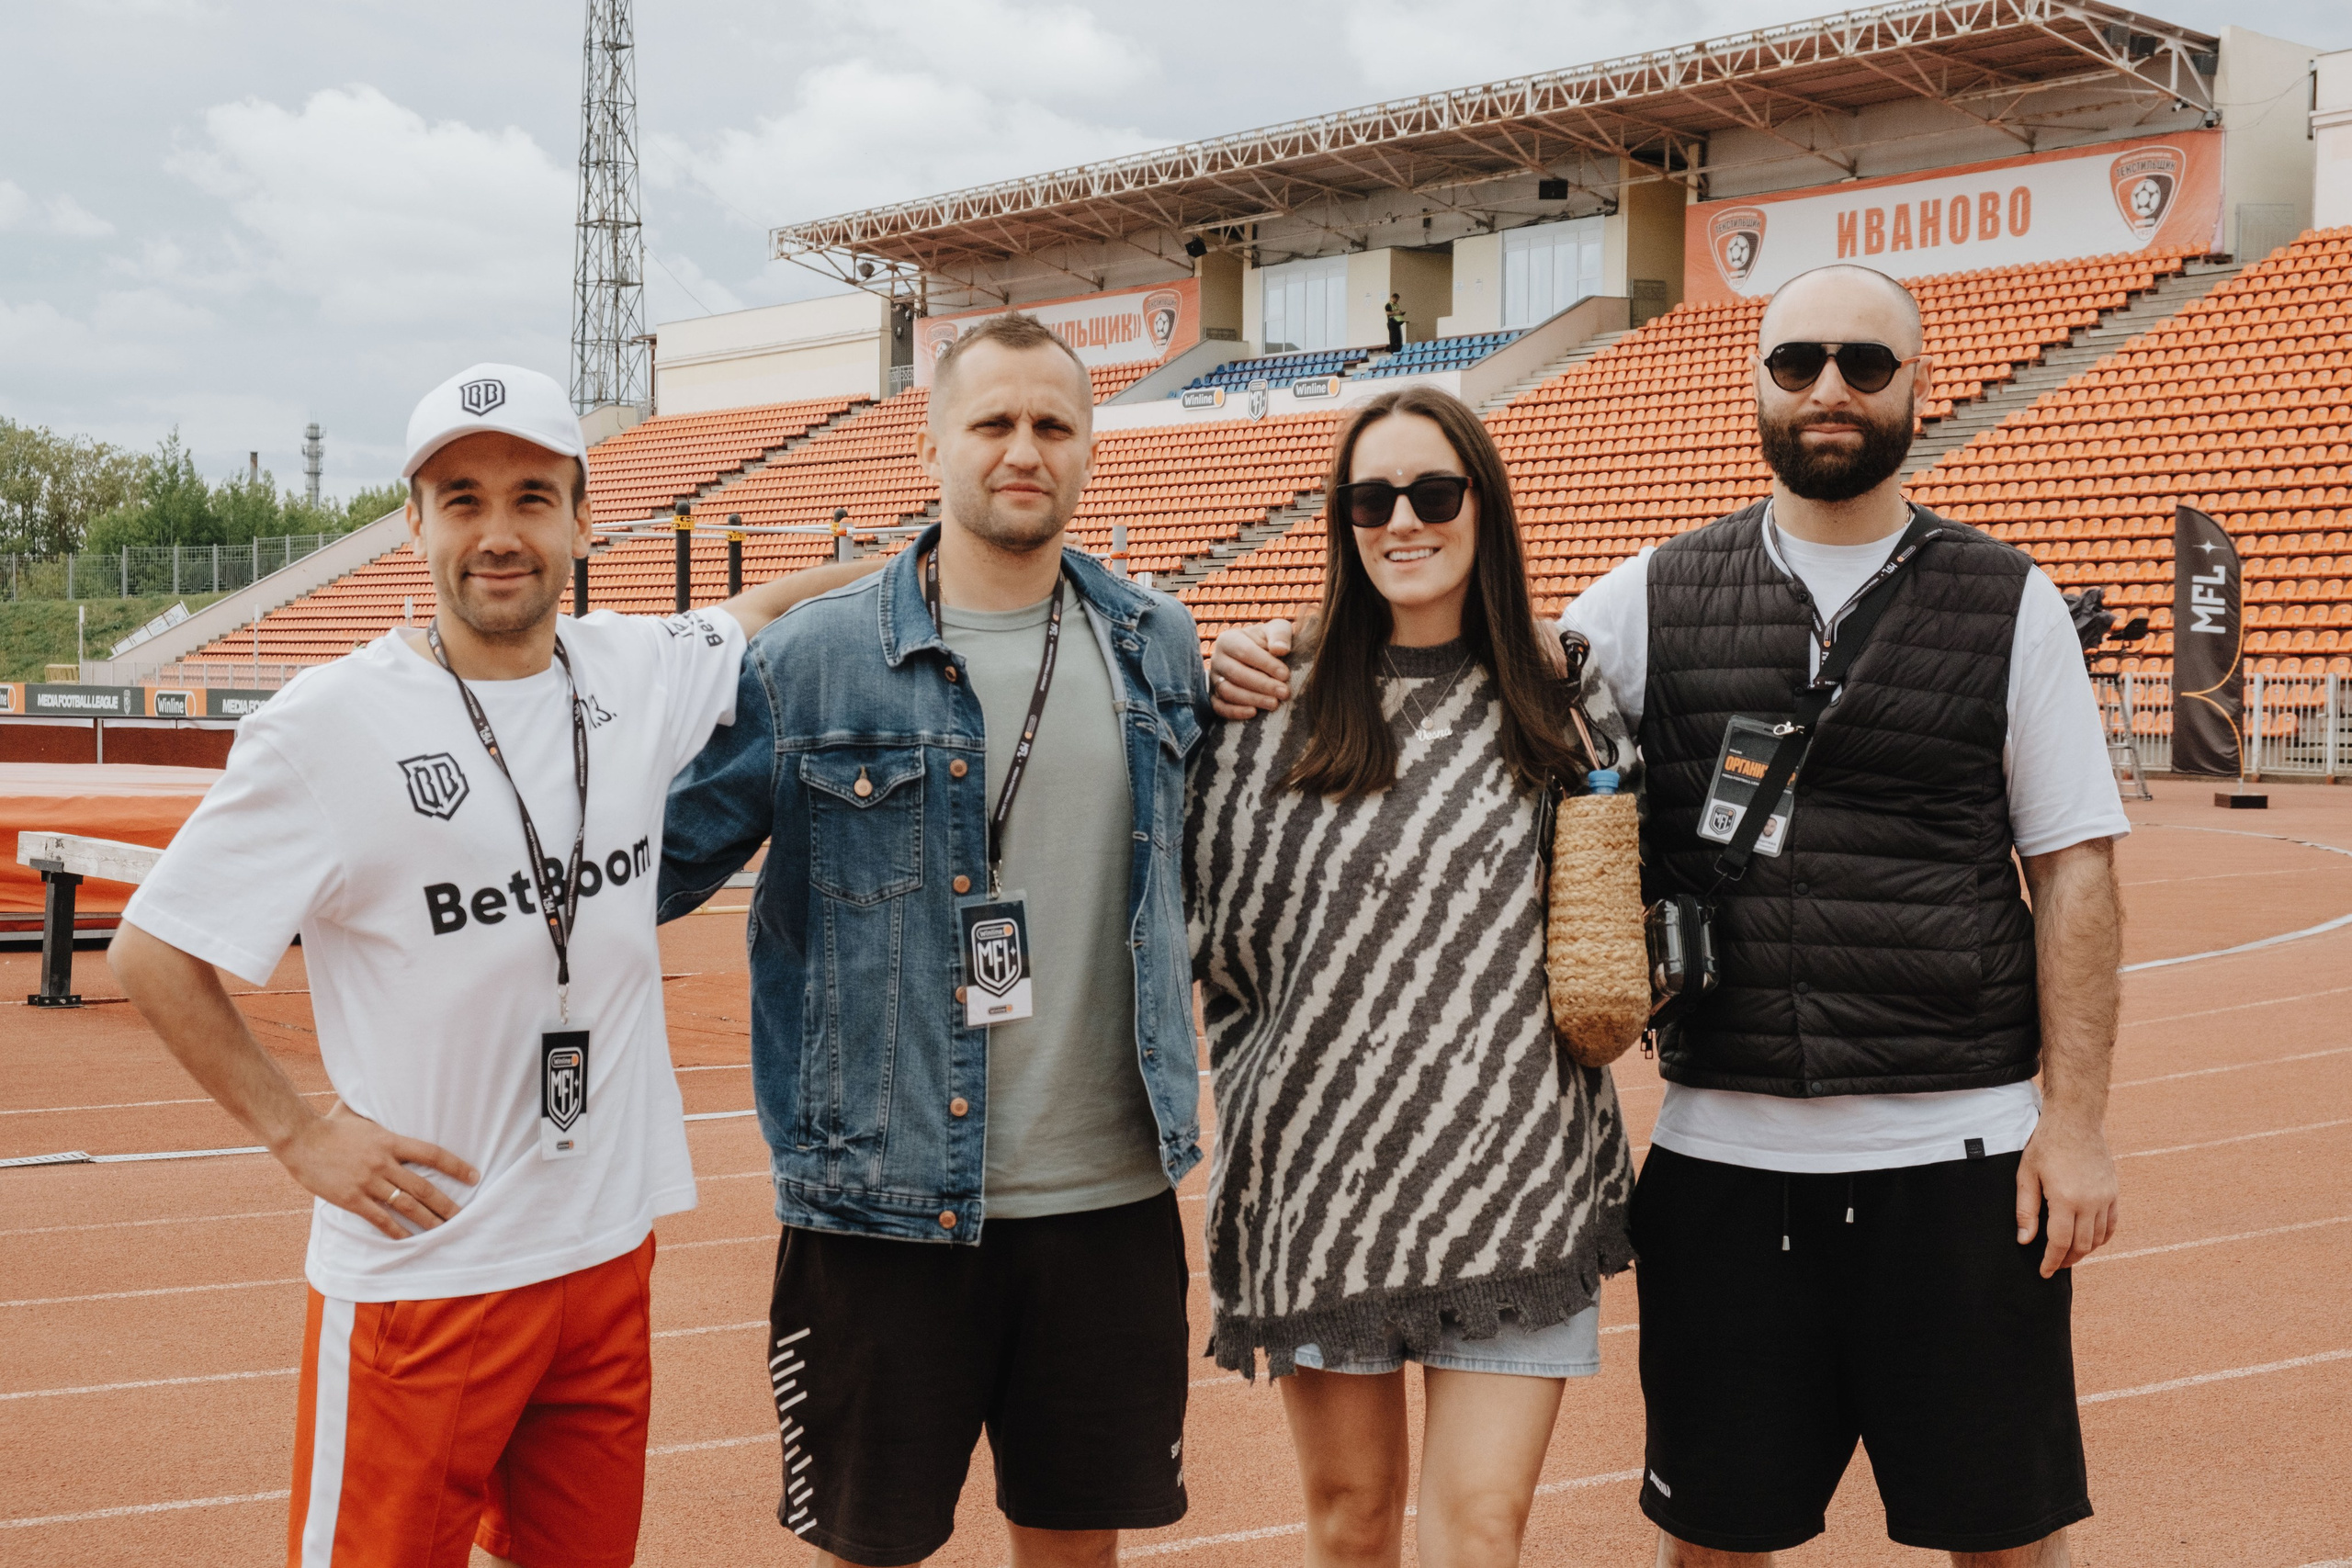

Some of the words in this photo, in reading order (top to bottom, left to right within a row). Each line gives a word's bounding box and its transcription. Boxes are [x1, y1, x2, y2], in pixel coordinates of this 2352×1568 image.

[2116, 159, 2177, 178] ТЕКСТИЛЬЩИК
[1838, 186, 2031, 259] ИВАНОВО
[1295, 383, 1327, 396] Winline
[1184, 394, 1213, 406] Winline
[2190, 565, 2226, 634] MFL
[38, 694, 58, 707] MEDIA
[58, 694, 91, 709] FOOTBALL
[92, 695, 119, 710] LEAGUE
[157, 697, 185, 715] Winline
[222, 698, 248, 714] MEDIA
[424, 834, 651, 935] BetBoom
[977, 939, 1017, 988] MFL
[551, 1068, 579, 1122] MFL
